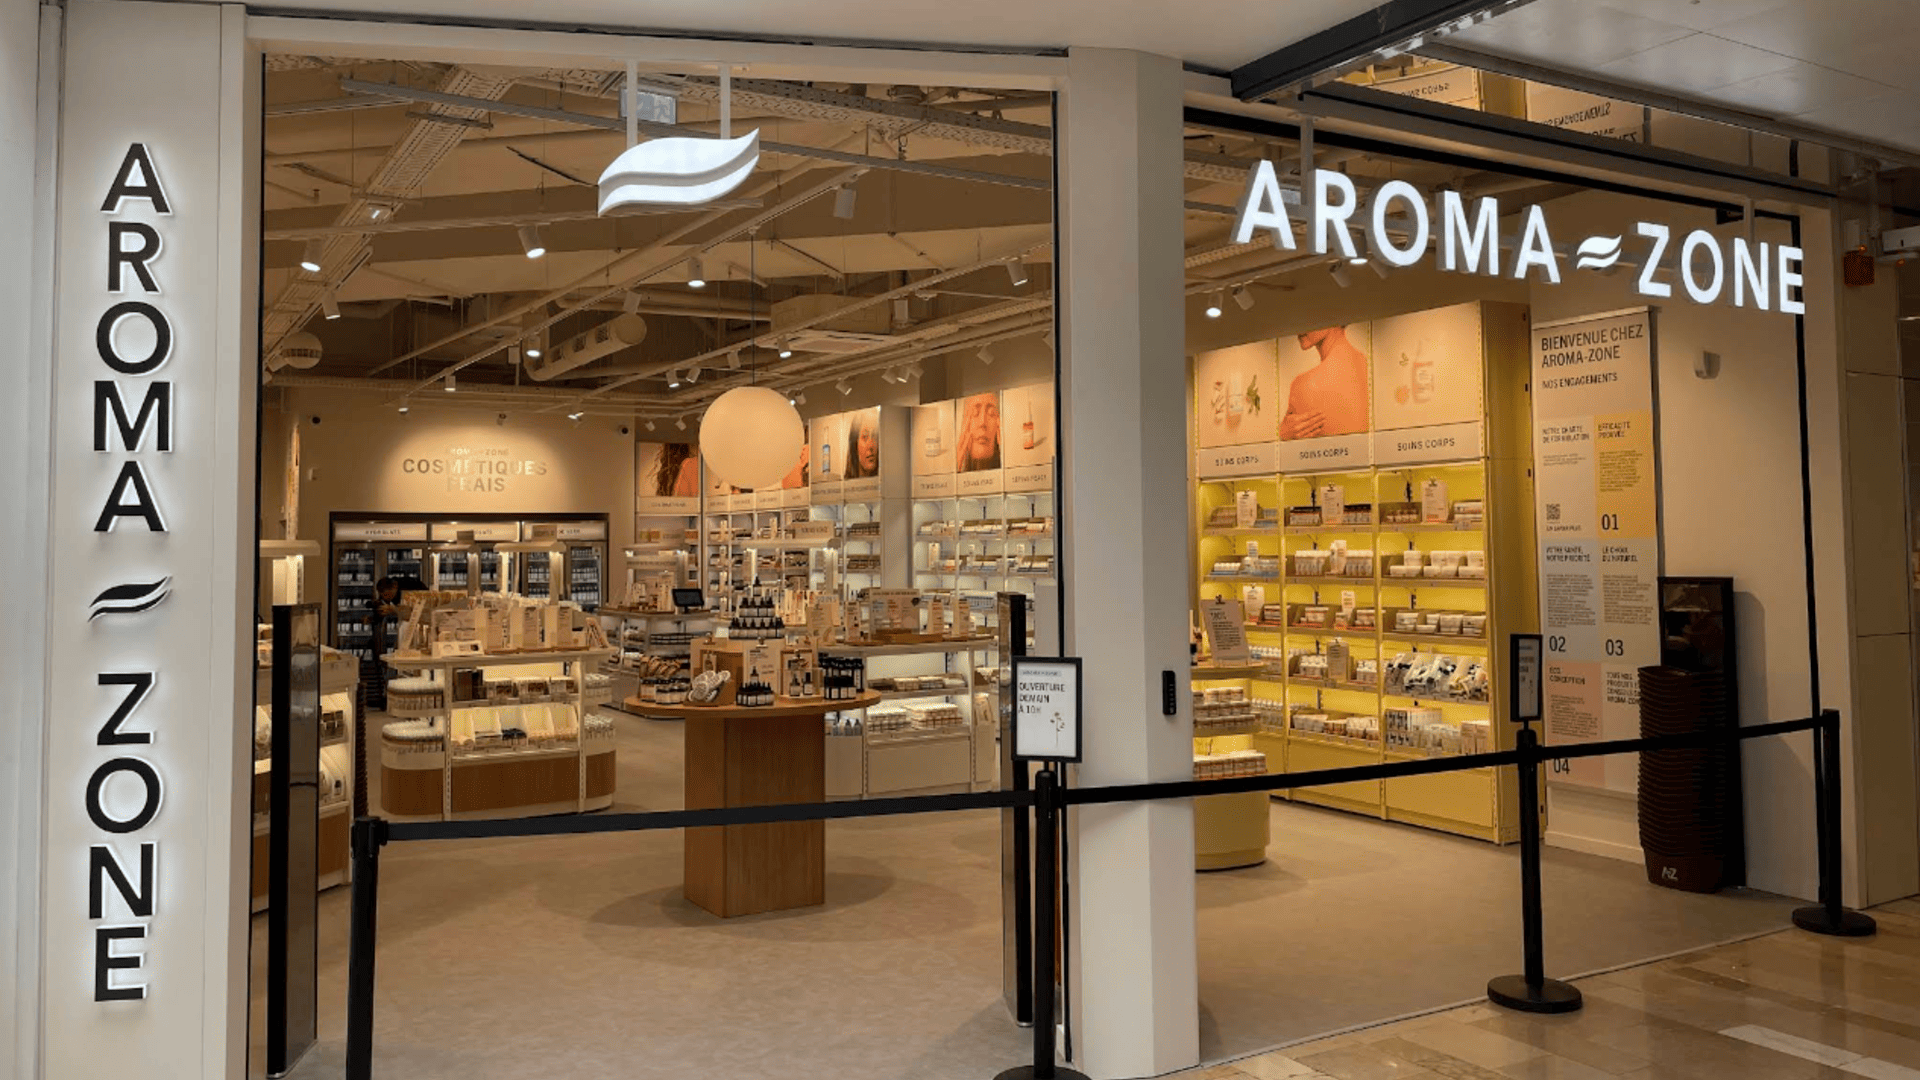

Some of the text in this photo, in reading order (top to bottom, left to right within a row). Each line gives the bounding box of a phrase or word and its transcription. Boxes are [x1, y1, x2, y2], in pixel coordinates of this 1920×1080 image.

[1231, 158, 1806, 315] AROMA ZONE
[94, 142, 173, 533] AROMA
[1541, 324, 1644, 351] BIENVENUE CHEZ
[1541, 345, 1621, 368] AROMA-ZONE
[1542, 372, 1618, 390] NOS ENGAGEMENTS
[1397, 437, 1456, 452] SOINS CORPS
[1215, 454, 1259, 467] SOINS CORPS
[1300, 447, 1349, 460] SOINS CORPS
[447, 477, 505, 492] FRAIS
[1601, 513, 1619, 530] 01
[1549, 635, 1566, 653] 02
[1605, 638, 1624, 656] 03
[1019, 682, 1066, 692] OUVERTURE
[1019, 694, 1050, 703] DEMAIN
[1553, 758, 1571, 775] 04
[85, 671, 162, 1003] ZONE
